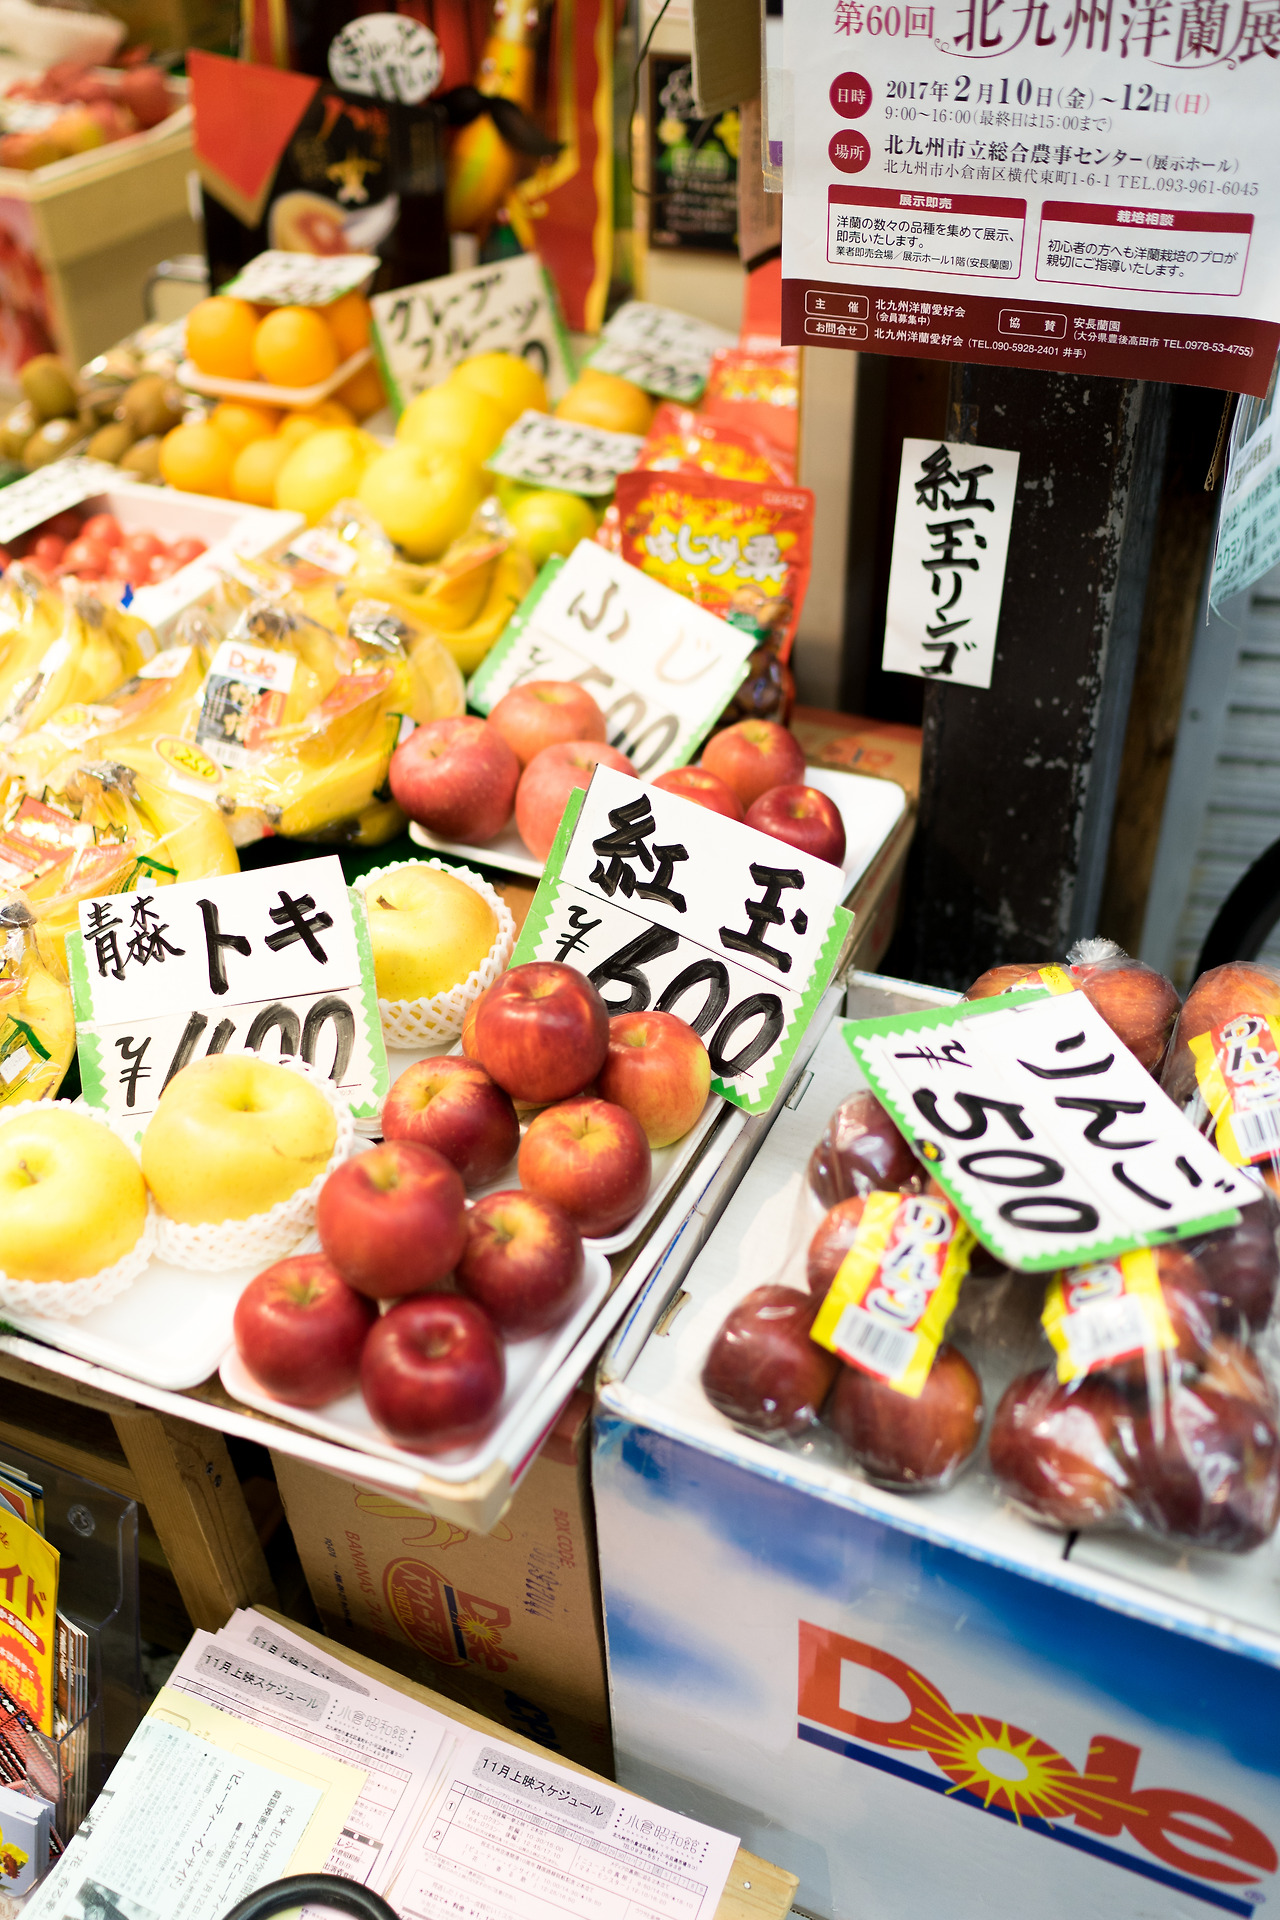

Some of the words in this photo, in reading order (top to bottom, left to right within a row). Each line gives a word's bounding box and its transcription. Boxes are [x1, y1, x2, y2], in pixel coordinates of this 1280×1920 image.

[834, 0, 935, 38] 第60回
[837, 88, 866, 105] 日時
[835, 143, 865, 161] 場所
[1118, 175, 1259, 196] TEL.093-961-6045
[899, 193, 953, 210] 展示即売
[836, 215, 1015, 243] 洋蘭の数々の品種を集めて展示、
[1116, 209, 1175, 227] 栽培相談
[836, 230, 925, 249] 即売いたします。
[1048, 239, 1239, 265] 初心者の方へも洋蘭栽培のプロが
[1046, 254, 1185, 278] 親切にご指導いたします。
[875, 299, 966, 318] 北九州洋蘭愛好会
[876, 312, 931, 326] (会員募集中)
[815, 322, 858, 336] お問合せ
[874, 328, 964, 347] 北九州洋蘭愛好会
[1071, 317, 1121, 332] 安長蘭園
[1163, 339, 1254, 357] TEL.0978-53-4755)
[914, 444, 997, 676] 紅玉リンゴ
[566, 576, 722, 686] ふじ
[228, 649, 279, 681] Dole
[589, 793, 809, 974] 紅玉
[83, 895, 187, 981] 青森
[196, 890, 335, 995] トキ
[1016, 1031, 1237, 1211] りんご
[894, 1040, 1100, 1234] ¥500
[863, 1199, 954, 1327] りんご
[339, 1527, 378, 1595] BANANAS
[202, 1653, 320, 1710] 11月上映スケジュール
[337, 1703, 408, 1742] 小倉昭和館
[797, 1618, 1279, 1885] Dole
[479, 1756, 606, 1817] 11月上映スケジュール
[624, 1811, 701, 1854] 小倉昭和館
